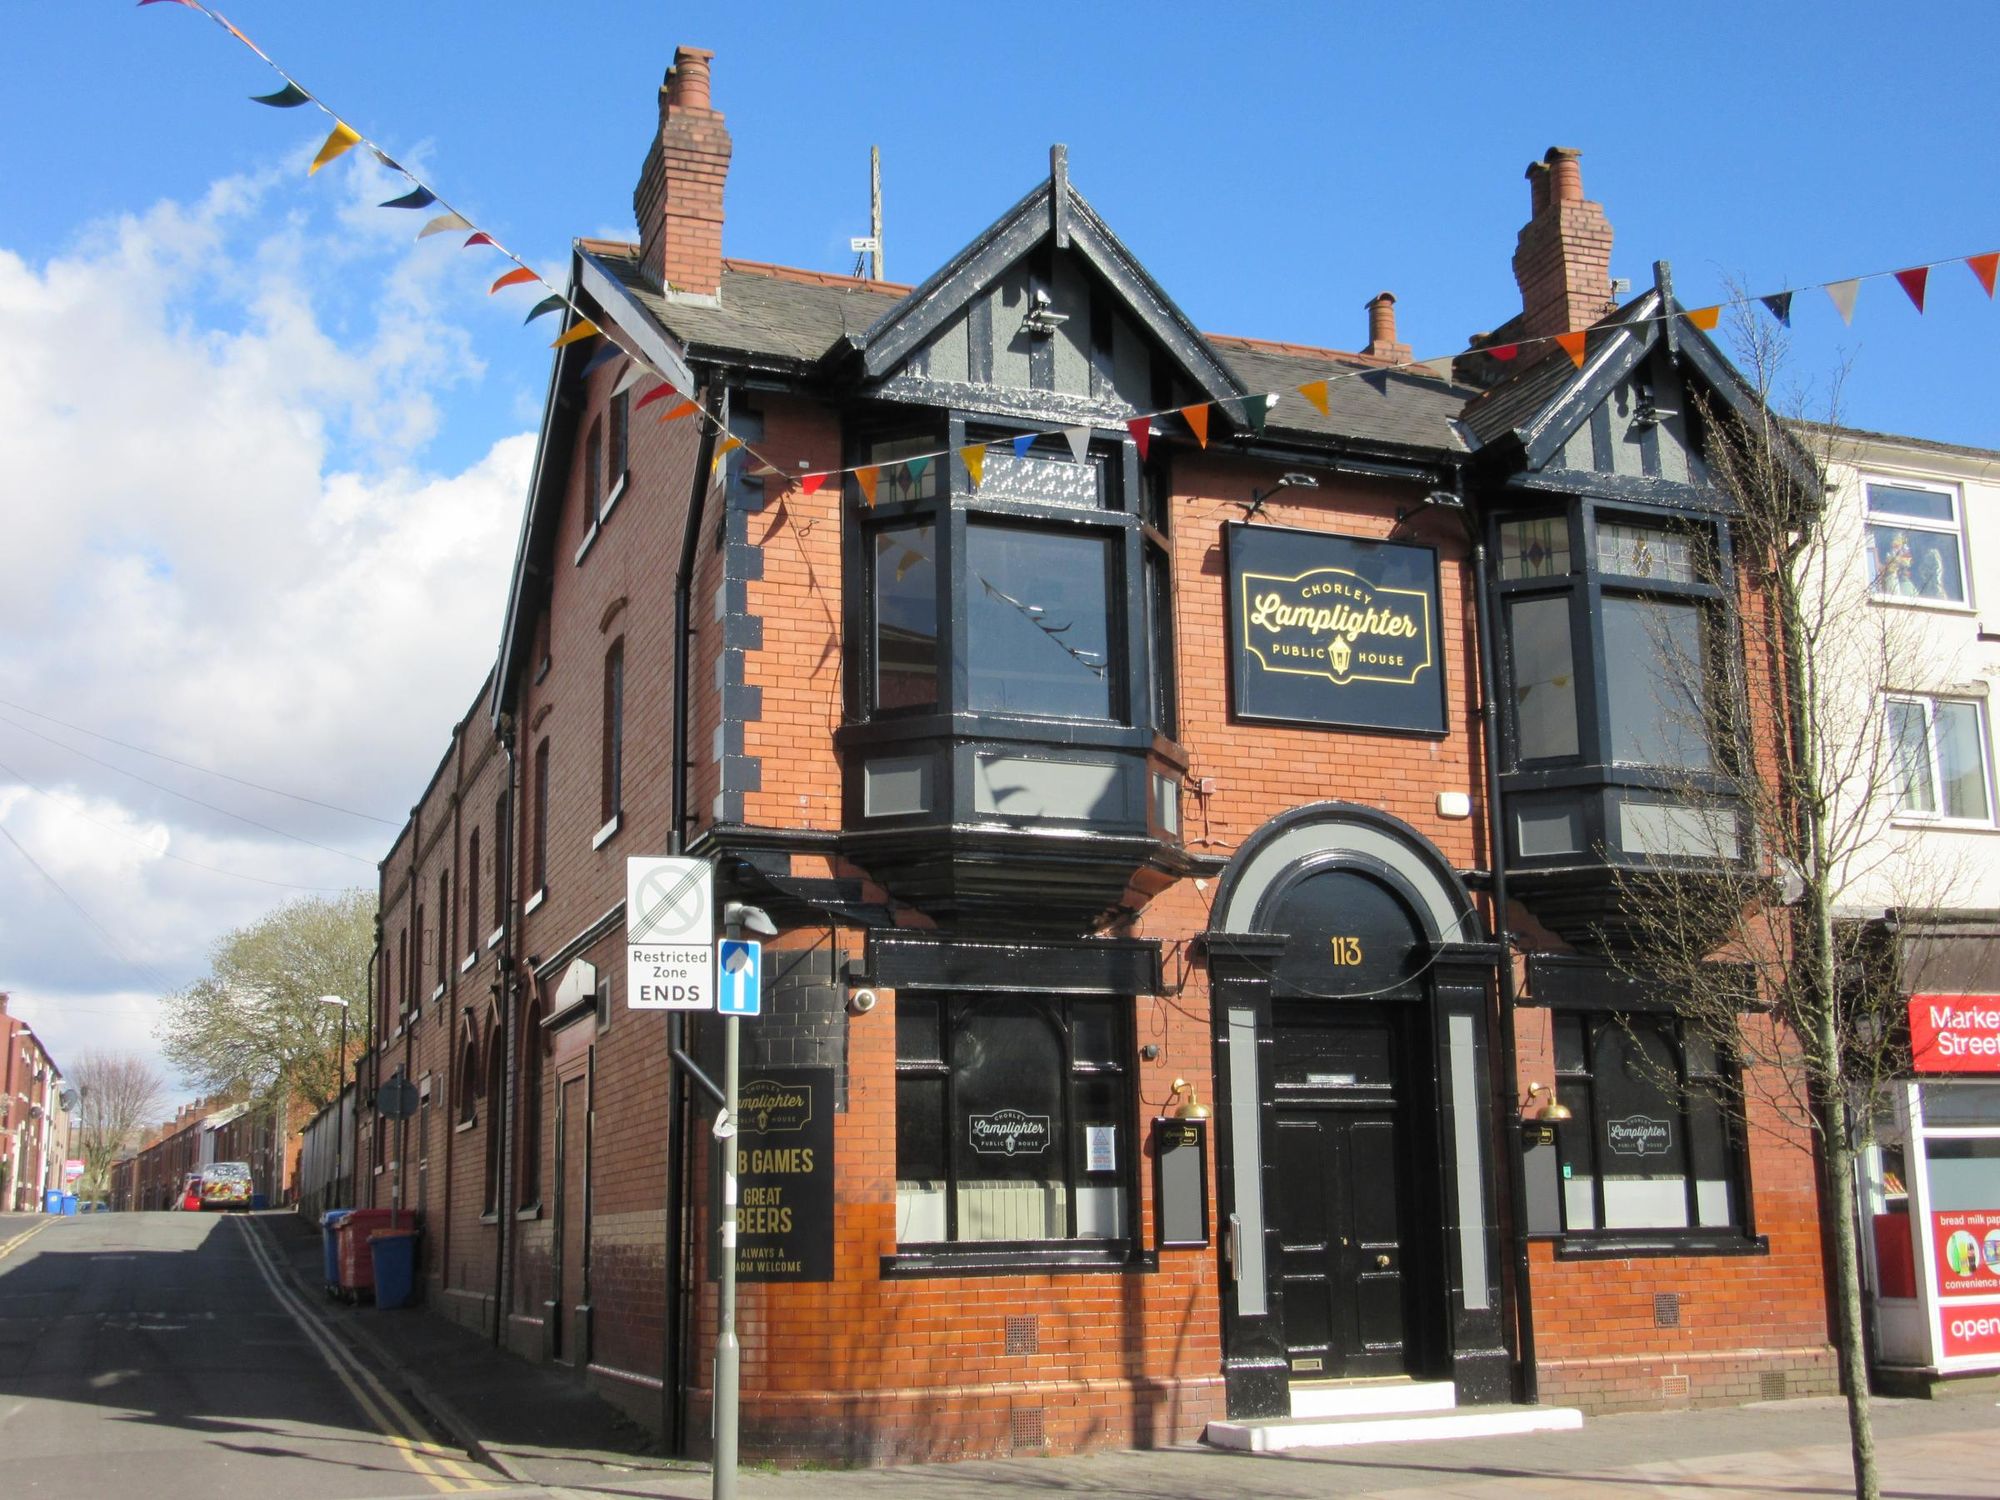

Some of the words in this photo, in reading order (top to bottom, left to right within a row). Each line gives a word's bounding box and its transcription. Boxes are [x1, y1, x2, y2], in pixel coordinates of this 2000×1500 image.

[1302, 584, 1371, 604] CHORLEY
[1251, 593, 1417, 642] Lamplighter
[1272, 644, 1325, 659] PUBLIC
[1358, 652, 1404, 666] HOUSE
[633, 950, 707, 963] Restricted
[1331, 936, 1362, 966] 113
[653, 966, 687, 978] Zone
[640, 985, 700, 1002] ENDS
[1929, 1005, 2000, 1029] Marke
[994, 1113, 1025, 1121] CHORLEY
[973, 1120, 1044, 1138] Lamplighter
[1610, 1125, 1666, 1139] Lamplighter
[752, 1148, 814, 1174] GAMES
[743, 1187, 782, 1206] GREAT
[736, 1207, 793, 1234] BEERS
[1940, 1216, 1964, 1225] bread
[1967, 1214, 1985, 1225] milk
[741, 1247, 775, 1259] ALWAYS
[778, 1247, 784, 1258] A
[736, 1261, 753, 1272] ARM
[757, 1261, 801, 1273] WELCOME
[1945, 1277, 1998, 1289] convenience
[1951, 1317, 2000, 1341] open
